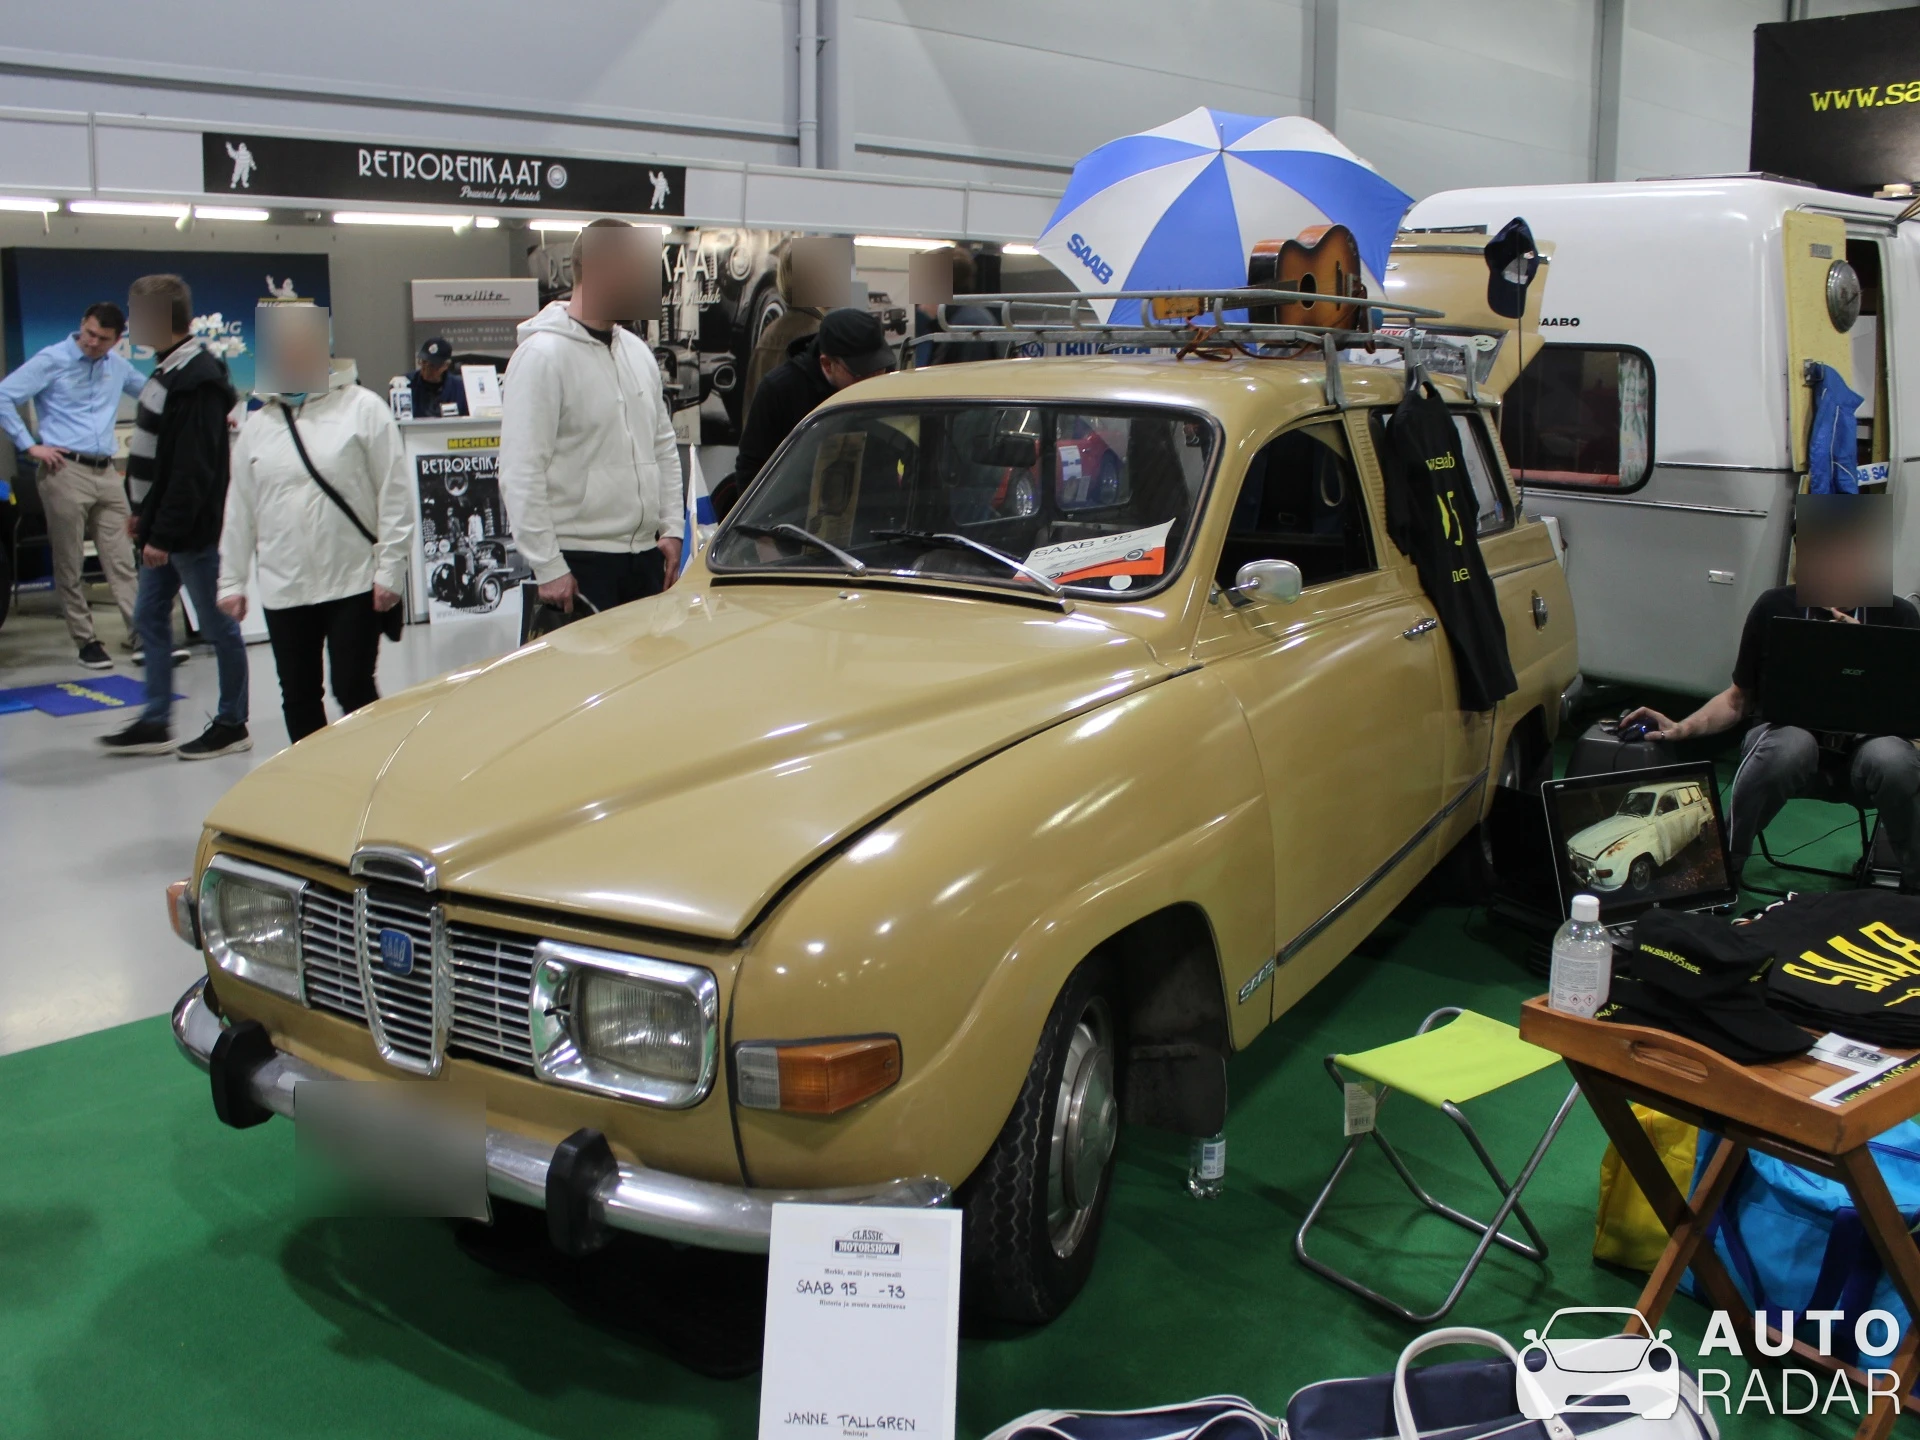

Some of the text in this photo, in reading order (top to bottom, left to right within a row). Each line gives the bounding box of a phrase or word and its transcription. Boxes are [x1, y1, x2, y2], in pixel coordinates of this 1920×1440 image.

[358, 149, 542, 186] RETRORENKAAT
[459, 185, 496, 198] Powered
[496, 187, 508, 203] by
[1067, 233, 1113, 285] SAAB
[440, 290, 506, 302] maxilite
[1539, 317, 1580, 327] AABO
[1034, 541, 1095, 557] SAAB
[1102, 534, 1132, 545] 95
[852, 1229, 884, 1241] CLASSIC
[837, 1241, 897, 1254] MOTORSHOW
[796, 1280, 834, 1295] SAAB
[840, 1282, 858, 1296] 95
[784, 1412, 916, 1431] JANNE TALLGREN
